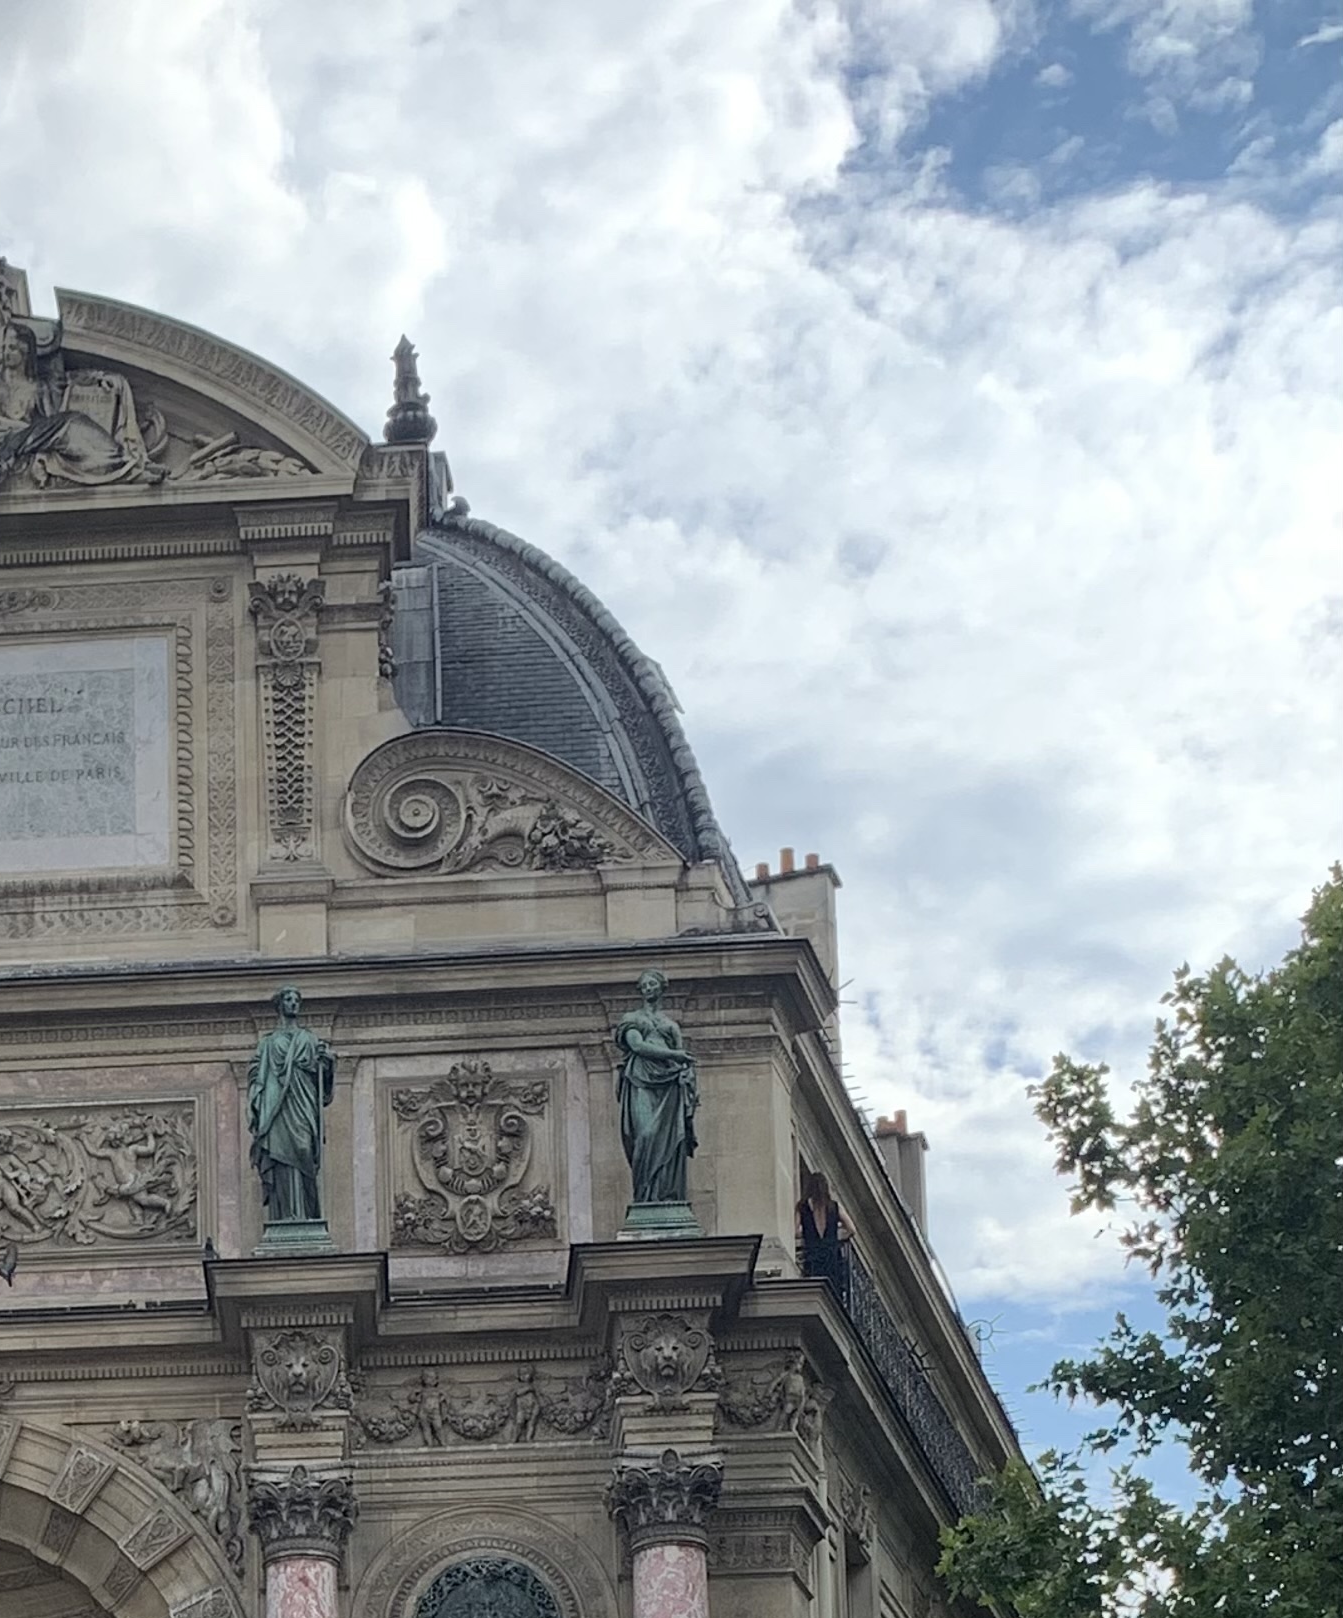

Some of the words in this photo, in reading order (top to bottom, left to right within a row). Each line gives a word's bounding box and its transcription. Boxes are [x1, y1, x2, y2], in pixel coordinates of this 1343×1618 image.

[23, 735, 49, 748] DES
[50, 769, 69, 782] DE
[76, 766, 123, 781] PARIS
